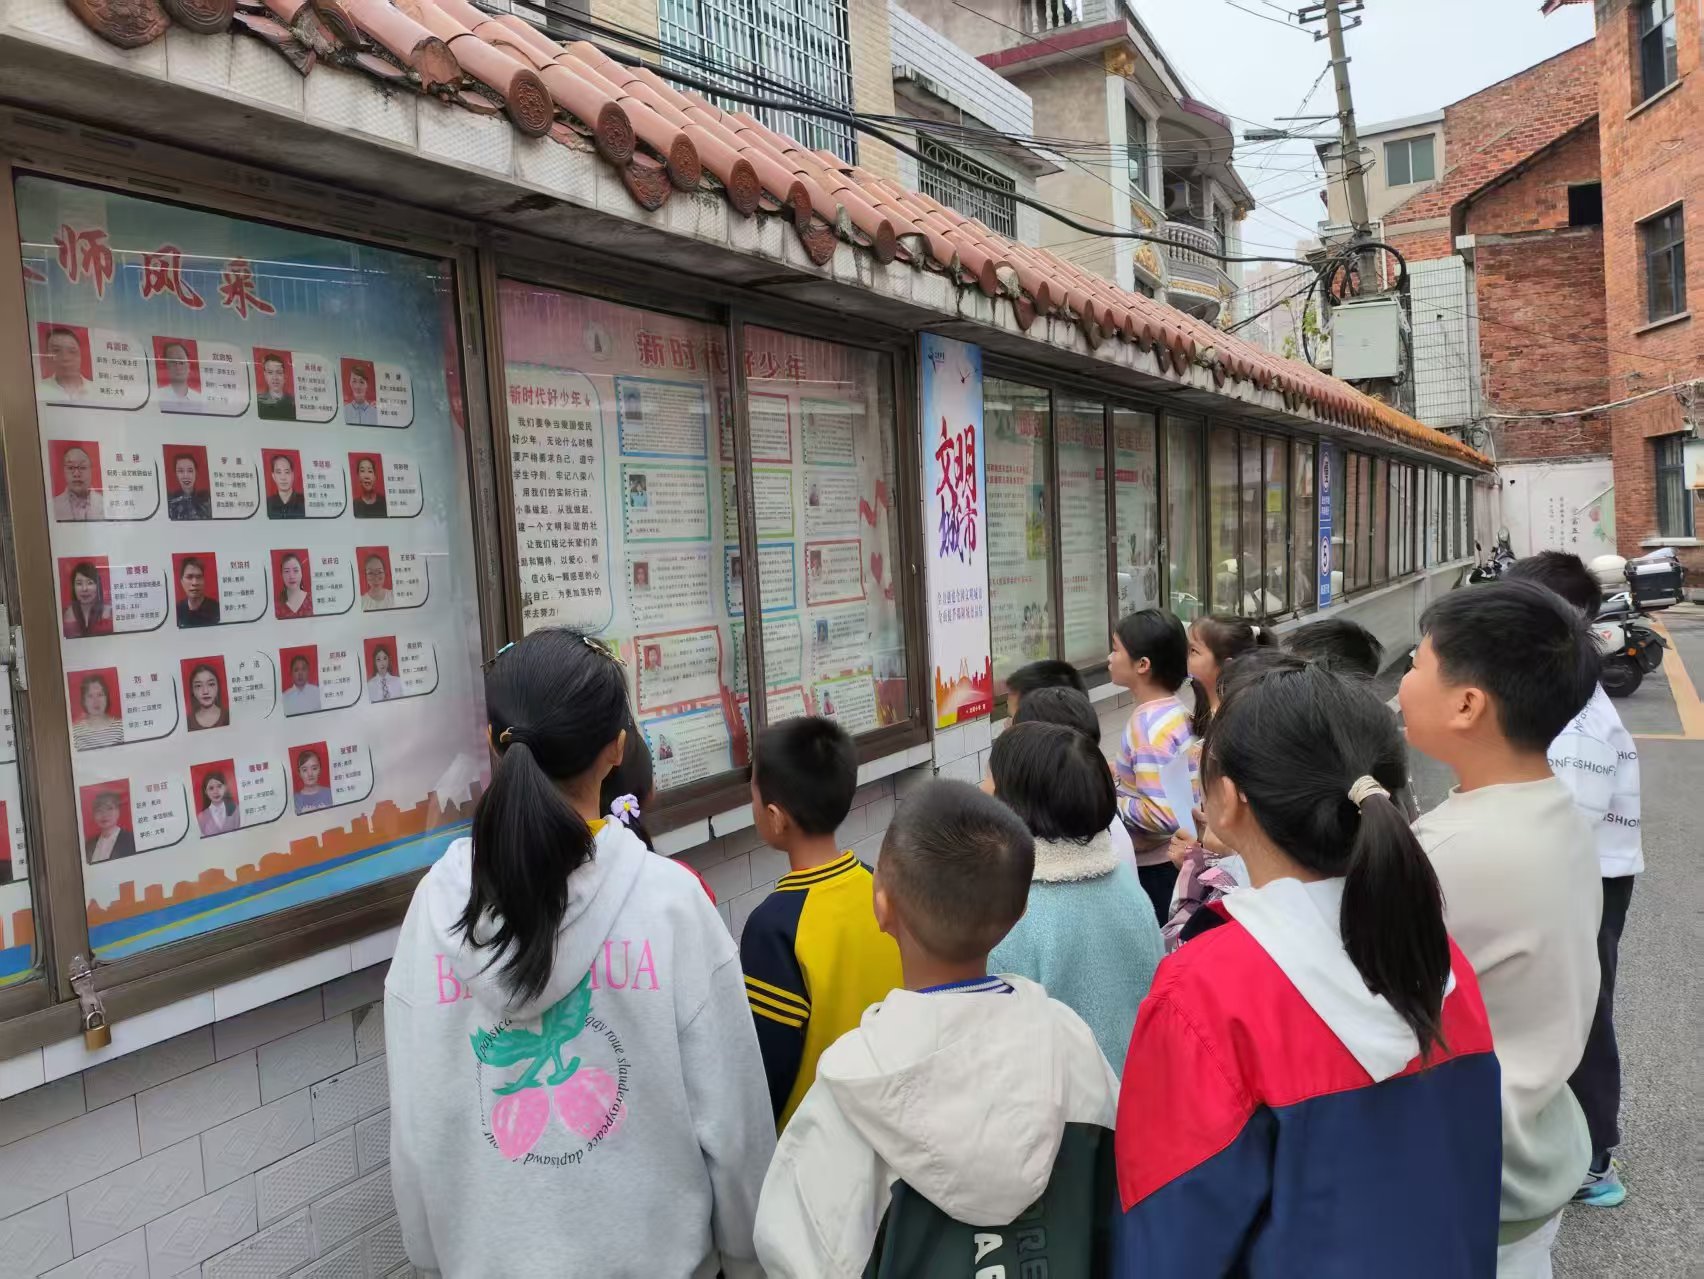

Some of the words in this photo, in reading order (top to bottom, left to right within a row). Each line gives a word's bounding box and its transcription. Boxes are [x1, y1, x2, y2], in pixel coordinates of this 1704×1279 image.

[22, 222, 276, 319] 师风采
[509, 384, 581, 408] 新时代好少年
